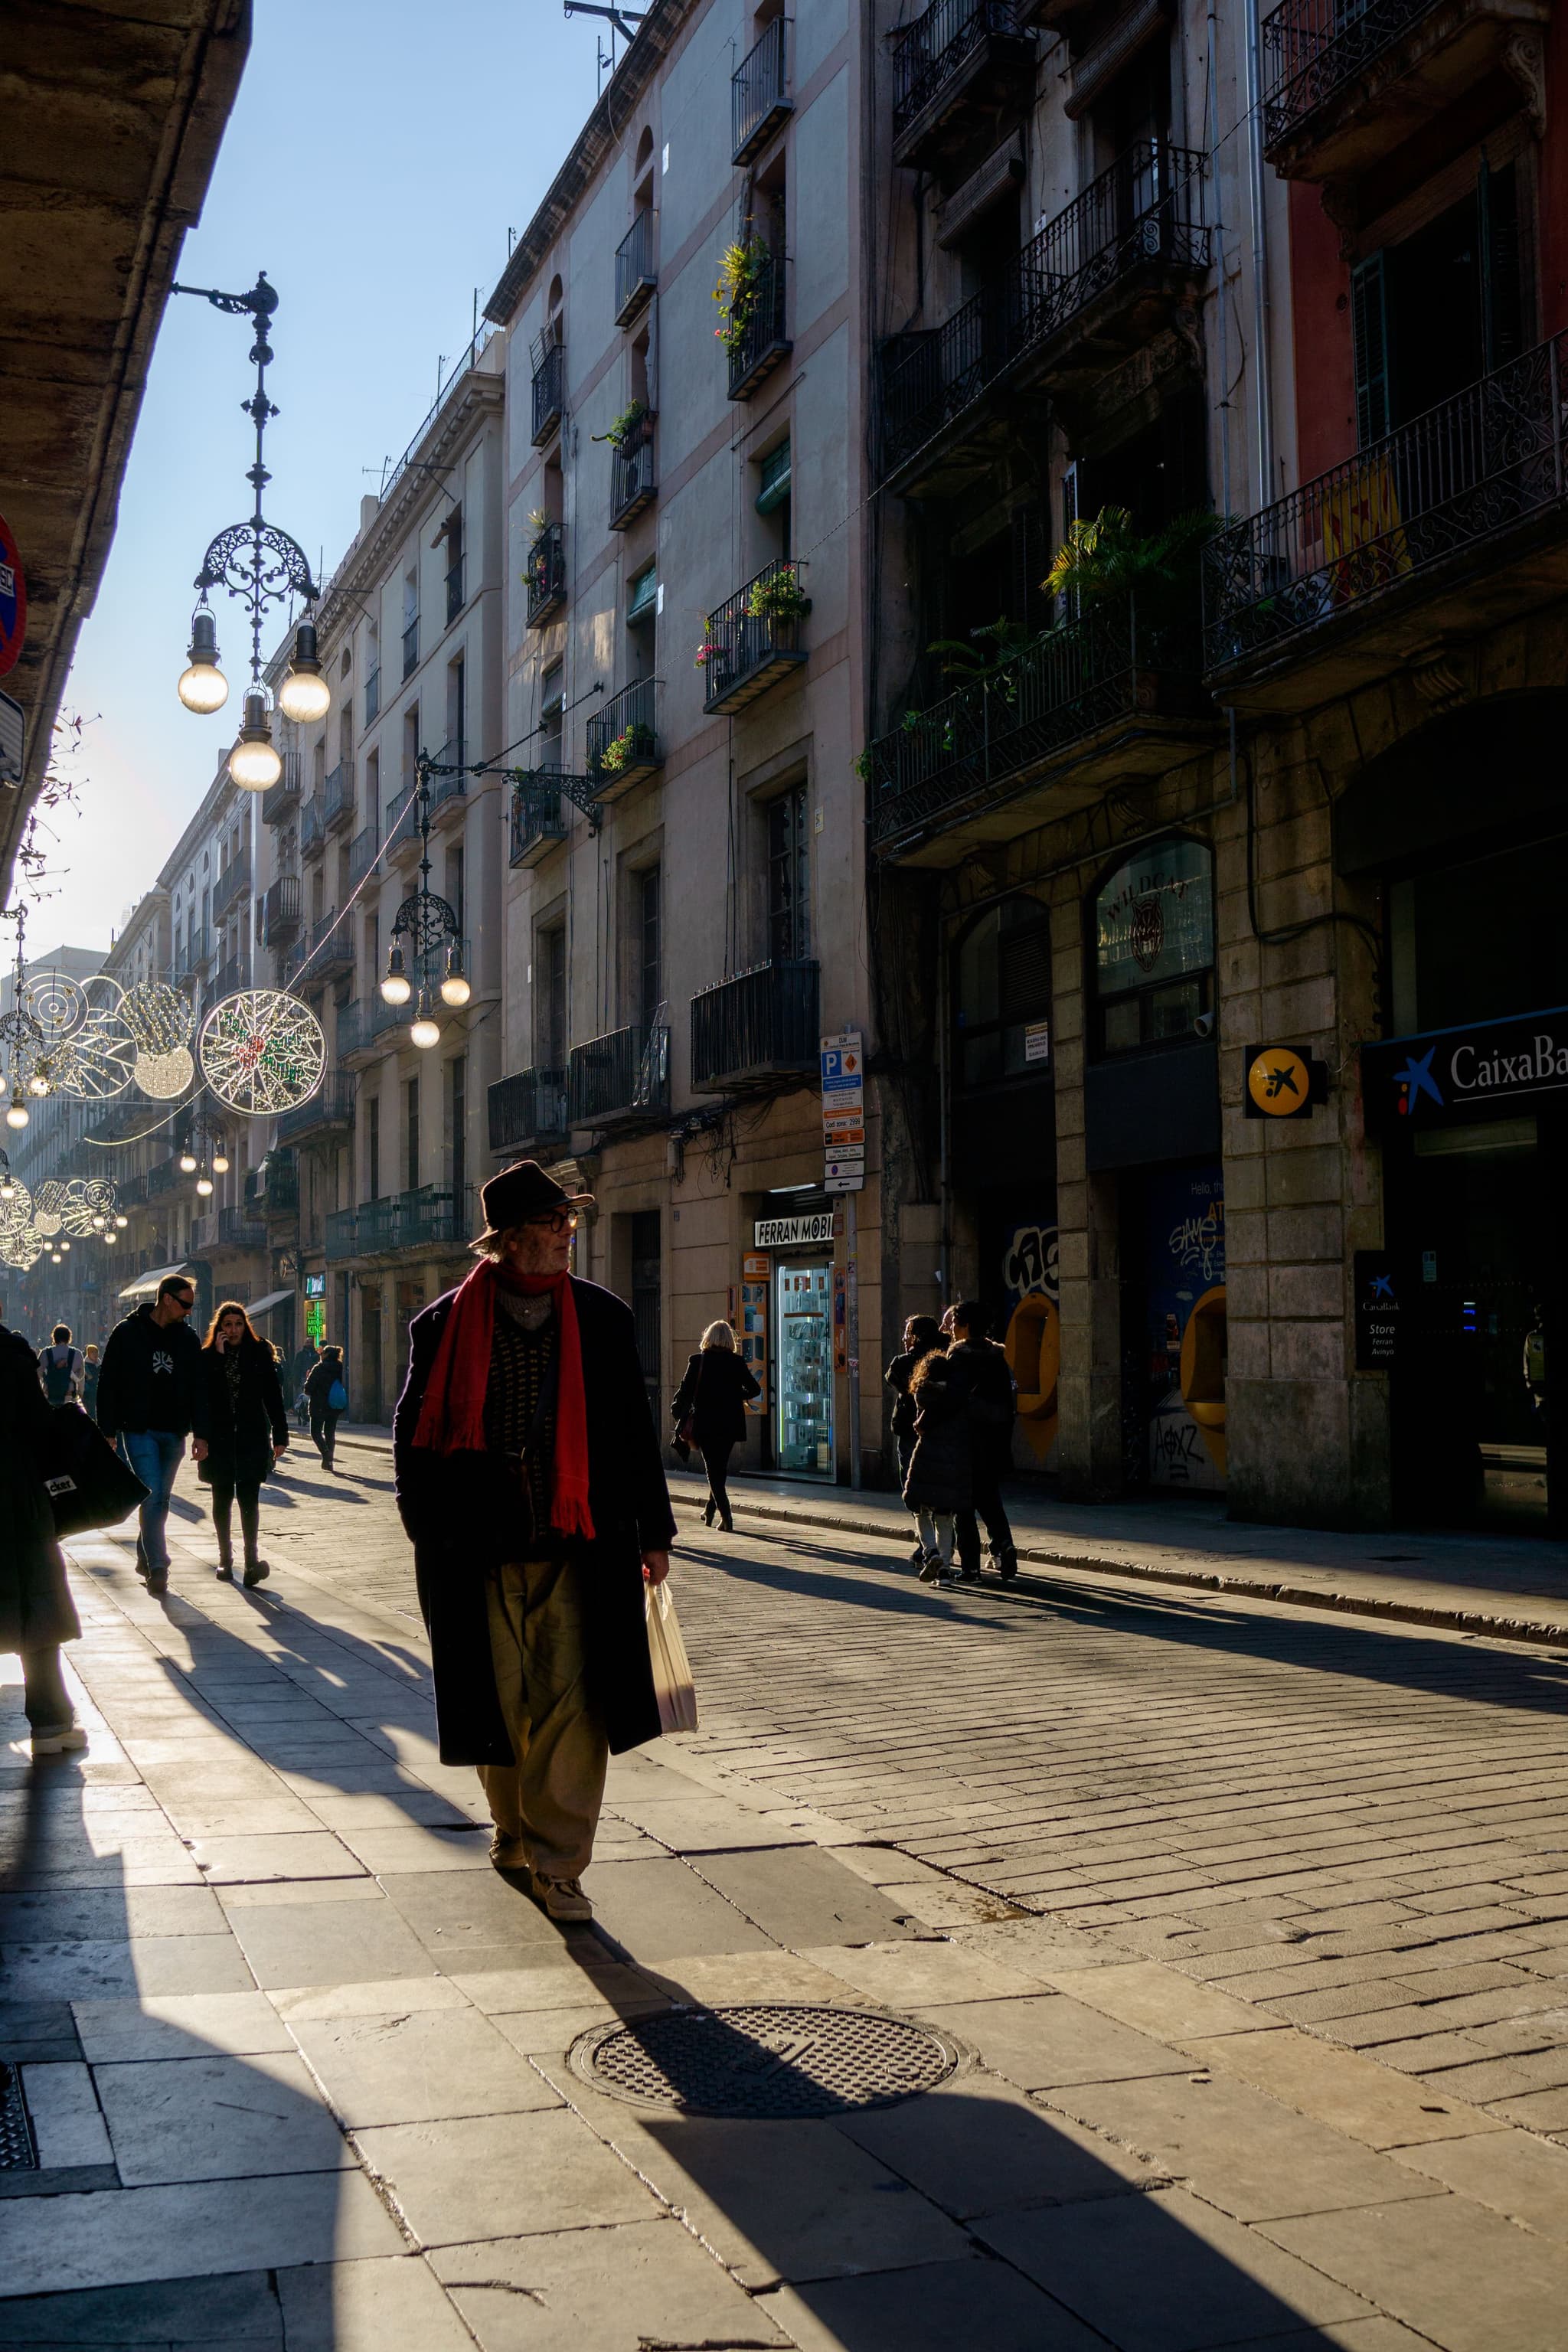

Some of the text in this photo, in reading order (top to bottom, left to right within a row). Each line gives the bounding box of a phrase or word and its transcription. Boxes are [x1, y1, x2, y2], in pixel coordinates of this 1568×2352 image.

[1107, 872, 1188, 920] WILDCAT
[825, 1053, 838, 1075] P
[1450, 1034, 1568, 1089] CaixaBa
[1191, 1181, 1211, 1194] Hello,
[759, 1219, 799, 1245] FERRAN
[308, 1325, 323, 1334] KING
[1369, 1324, 1396, 1334] Store
[1372, 1338, 1393, 1346] Ferran
